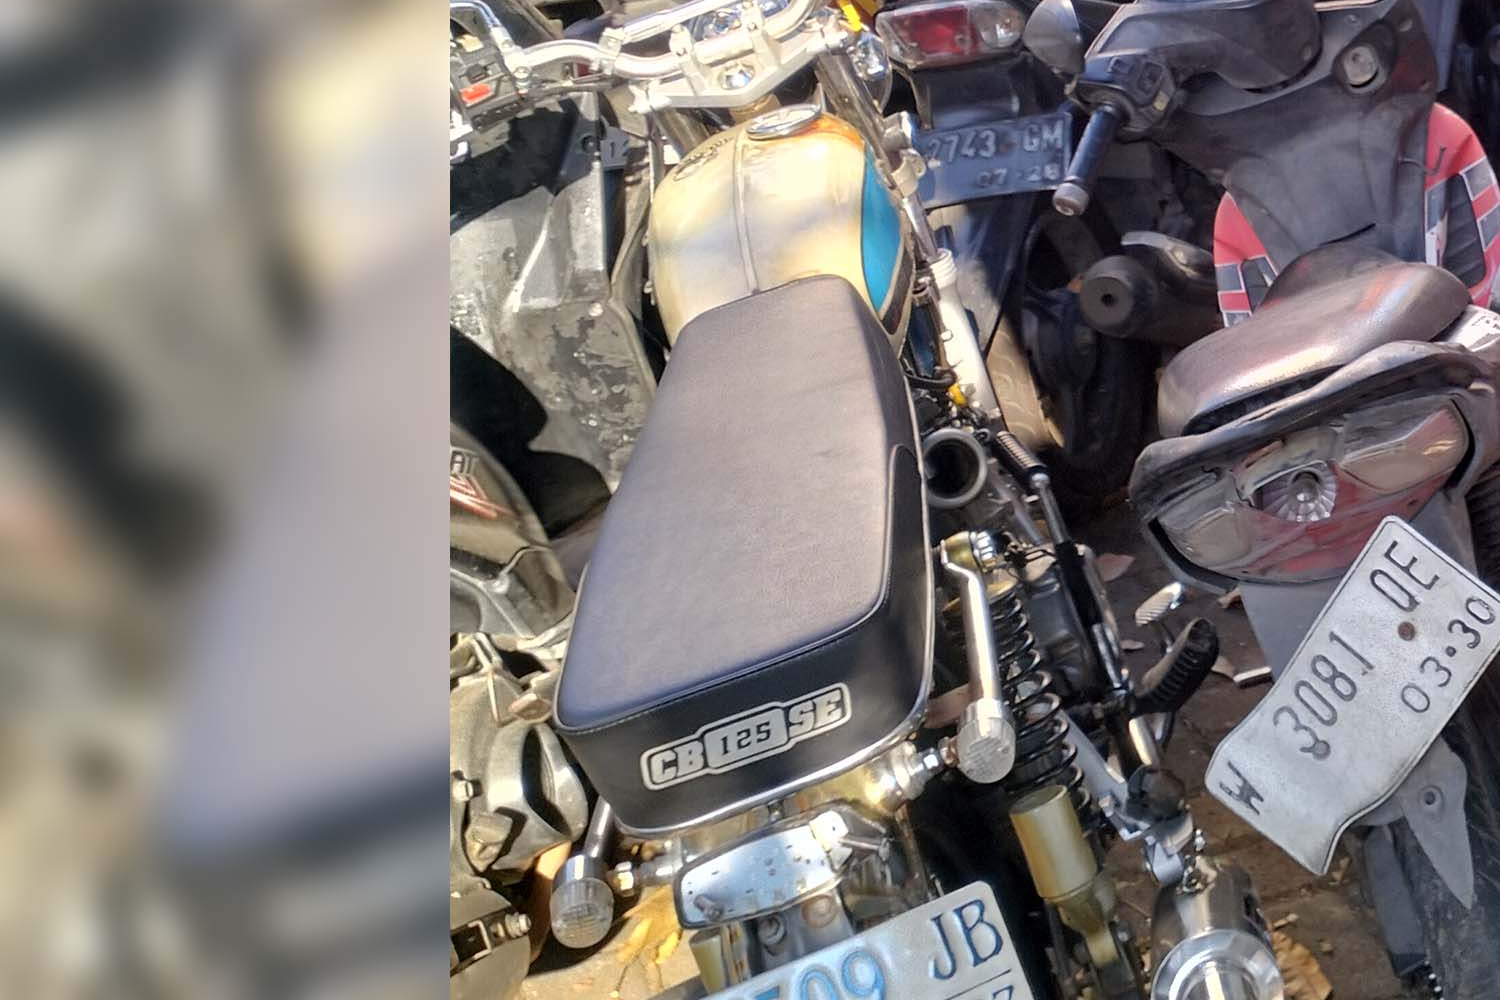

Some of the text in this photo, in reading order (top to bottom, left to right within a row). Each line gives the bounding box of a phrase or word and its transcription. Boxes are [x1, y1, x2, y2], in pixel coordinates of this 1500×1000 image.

[1023, 120, 1064, 151] GM
[1219, 541, 1440, 815] W 3081 QE
[650, 688, 844, 784] CB 125 SE
[930, 899, 1003, 980] JB
